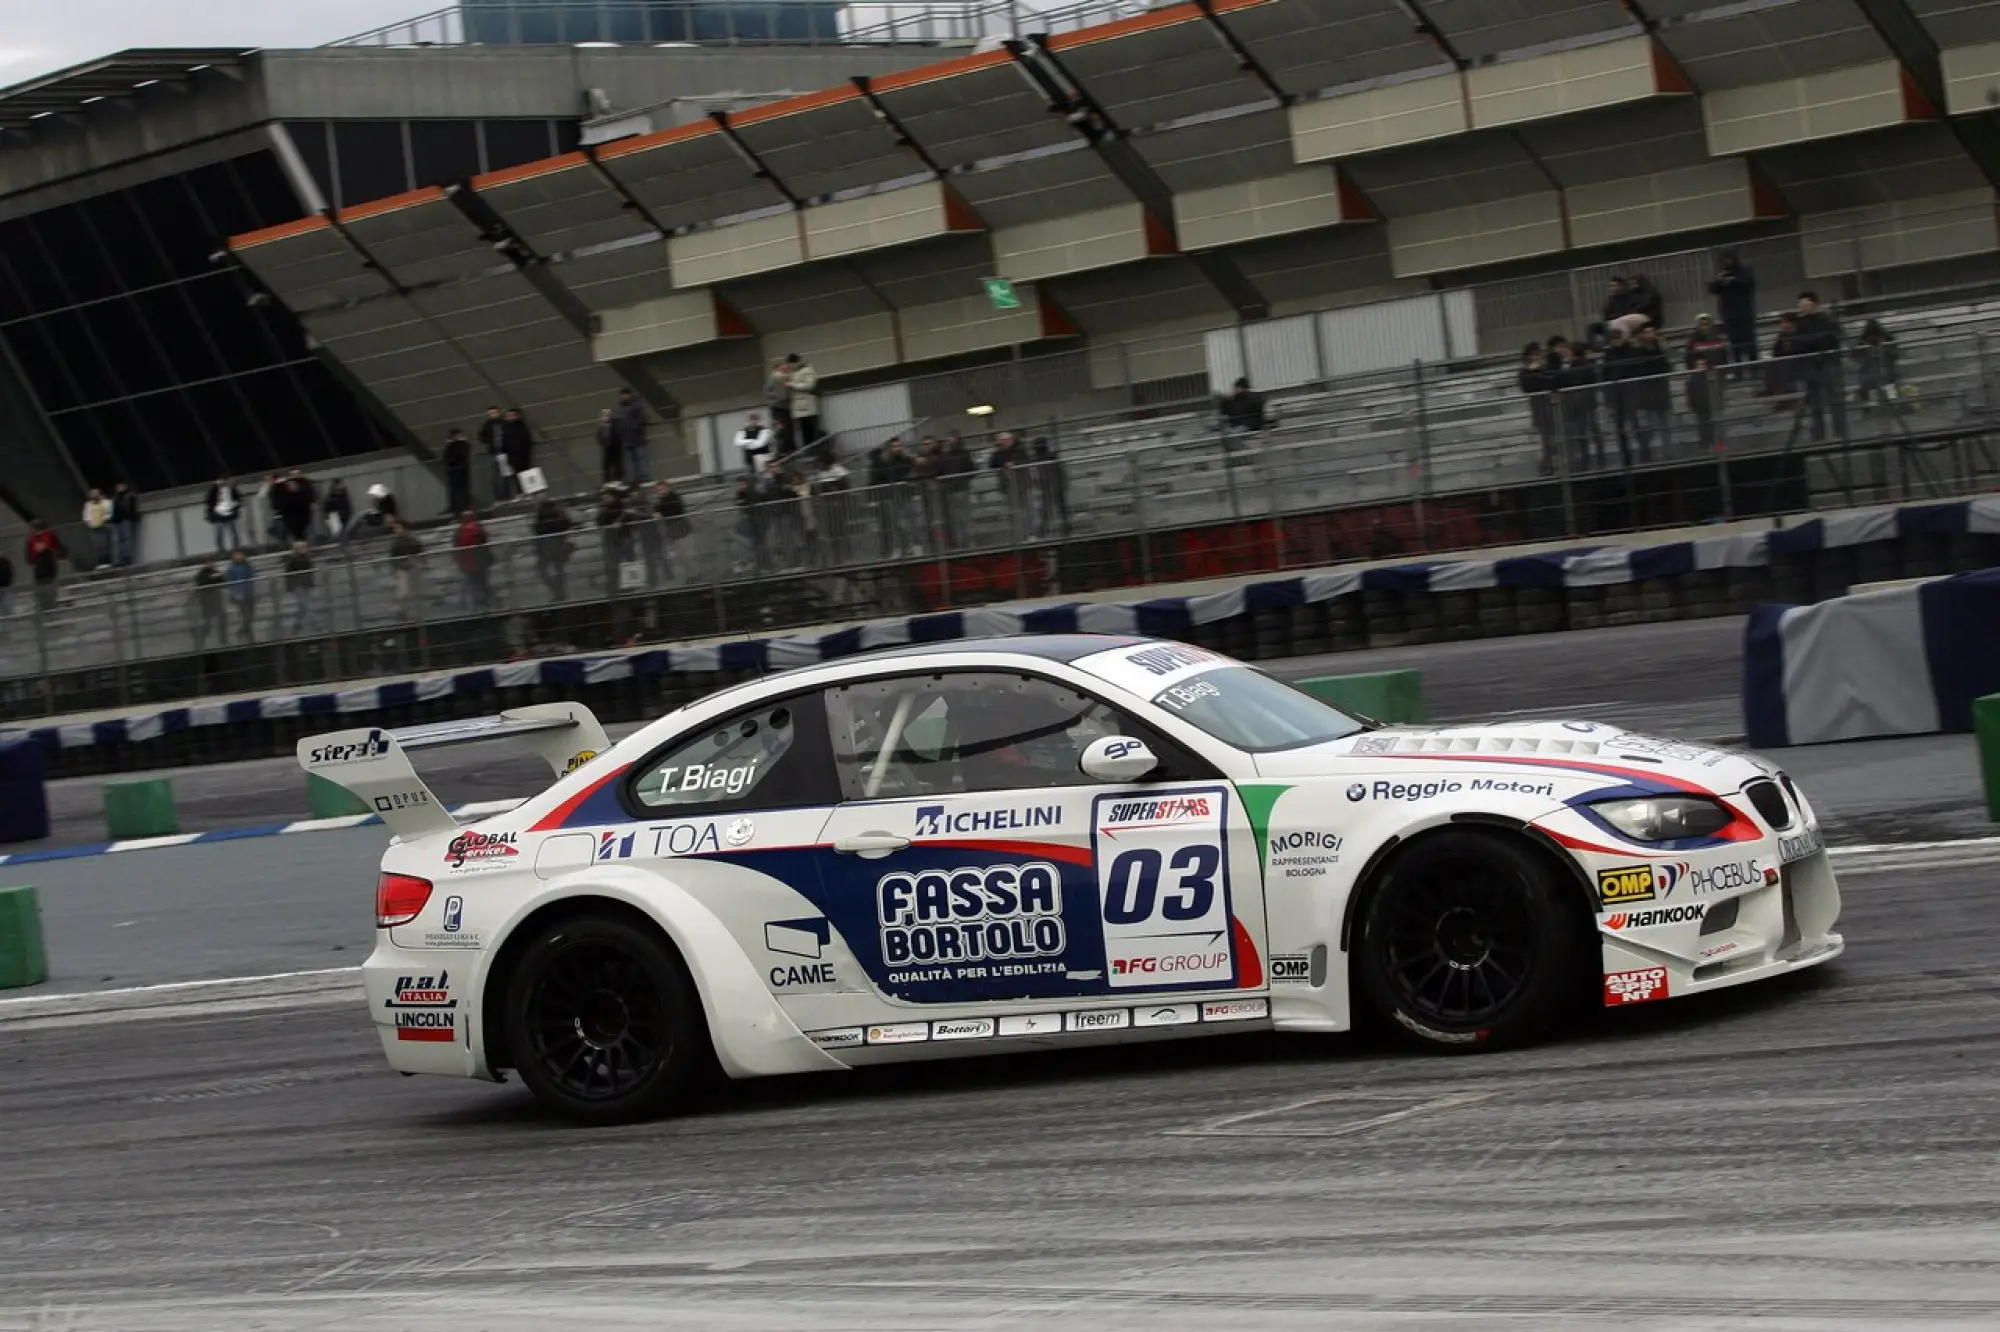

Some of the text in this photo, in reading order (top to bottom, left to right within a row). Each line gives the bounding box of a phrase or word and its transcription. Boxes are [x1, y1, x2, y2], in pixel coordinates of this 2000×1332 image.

[1372, 779, 1553, 801] Reggio Motori
[1108, 797, 1210, 822] SUPERSTARS
[448, 831, 517, 853] GLOBAL
[649, 823, 720, 855] TOA
[1270, 831, 1343, 854] MORIGI
[1285, 868, 1326, 877] BOLOGNA
[880, 864, 1060, 925] FASSA
[1103, 844, 1220, 925] 03
[1602, 872, 1652, 897] OMP
[883, 918, 1063, 964] BORTOLO
[889, 962, 1067, 983] QUALITÀ PER L'EDILIZIA
[1128, 952, 1228, 974] FG GROUP
[1272, 961, 1308, 976] OMP
[770, 963, 836, 986] CAME
[1605, 970, 1664, 985] AUTO
[402, 992, 443, 1000] ITALIA
[395, 1012, 454, 1027] LINCOLN
[1075, 1011, 1121, 1028] freem
